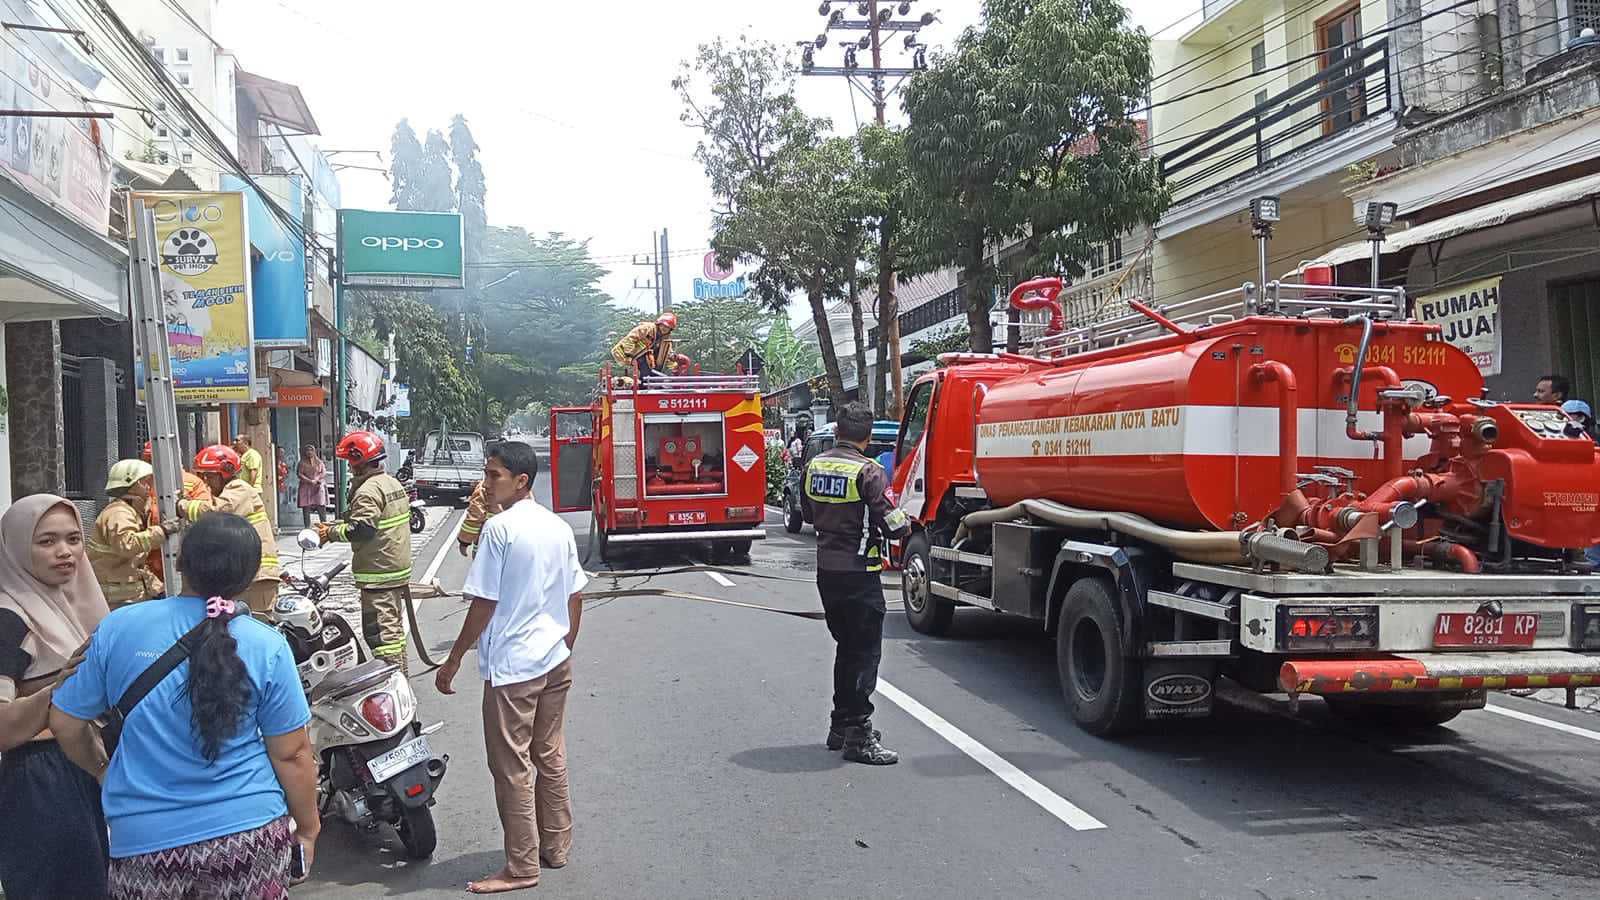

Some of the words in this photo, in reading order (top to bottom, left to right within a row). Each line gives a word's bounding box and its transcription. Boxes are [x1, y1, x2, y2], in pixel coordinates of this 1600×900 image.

[192, 294, 234, 309] MOOD
[1421, 286, 1498, 321] RUMAH
[1425, 312, 1497, 343] IJUA
[1403, 345, 1446, 366] 512111
[281, 392, 313, 401] Xiaomi
[670, 399, 707, 409] 512111
[979, 424, 996, 438] DINAS
[998, 420, 1061, 438] PENANGGULANGAN
[1063, 413, 1117, 433] KEBAKARAN
[1120, 410, 1146, 429] KOTA
[1151, 407, 1180, 427] BATU
[1044, 440, 1062, 456] 0341
[1065, 440, 1091, 455] 512111
[811, 475, 846, 496] POLISI
[1439, 615, 1450, 634] N
[1464, 615, 1503, 635] 8281
[1514, 615, 1535, 635] KP
